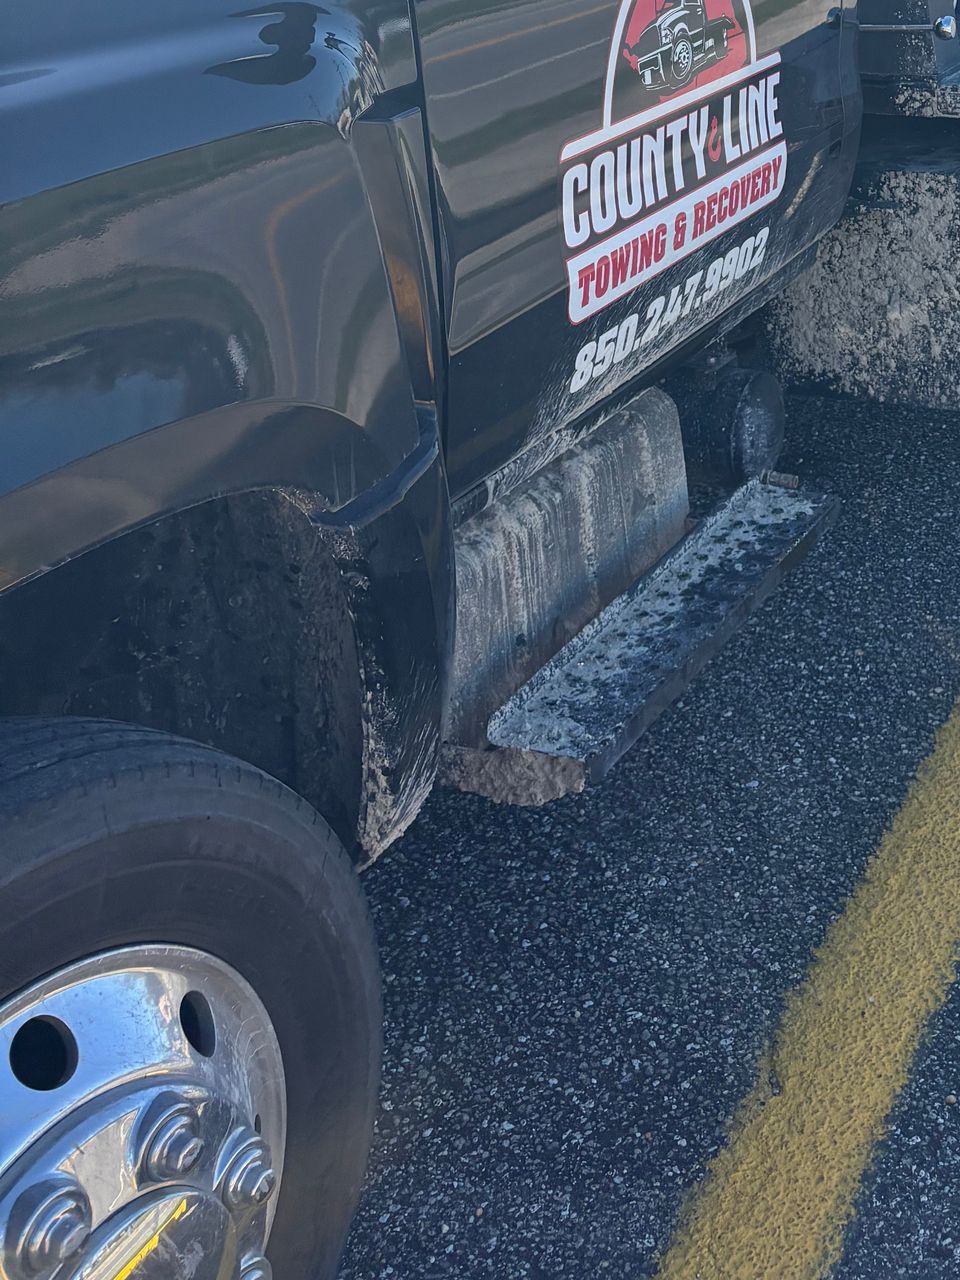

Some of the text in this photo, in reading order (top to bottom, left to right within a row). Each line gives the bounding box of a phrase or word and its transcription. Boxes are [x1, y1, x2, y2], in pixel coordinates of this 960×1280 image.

[563, 72, 783, 249] COUNTY LINE
[578, 155, 782, 308] TOWING & RECOVERY
[569, 227, 770, 394] 850.247.9902
